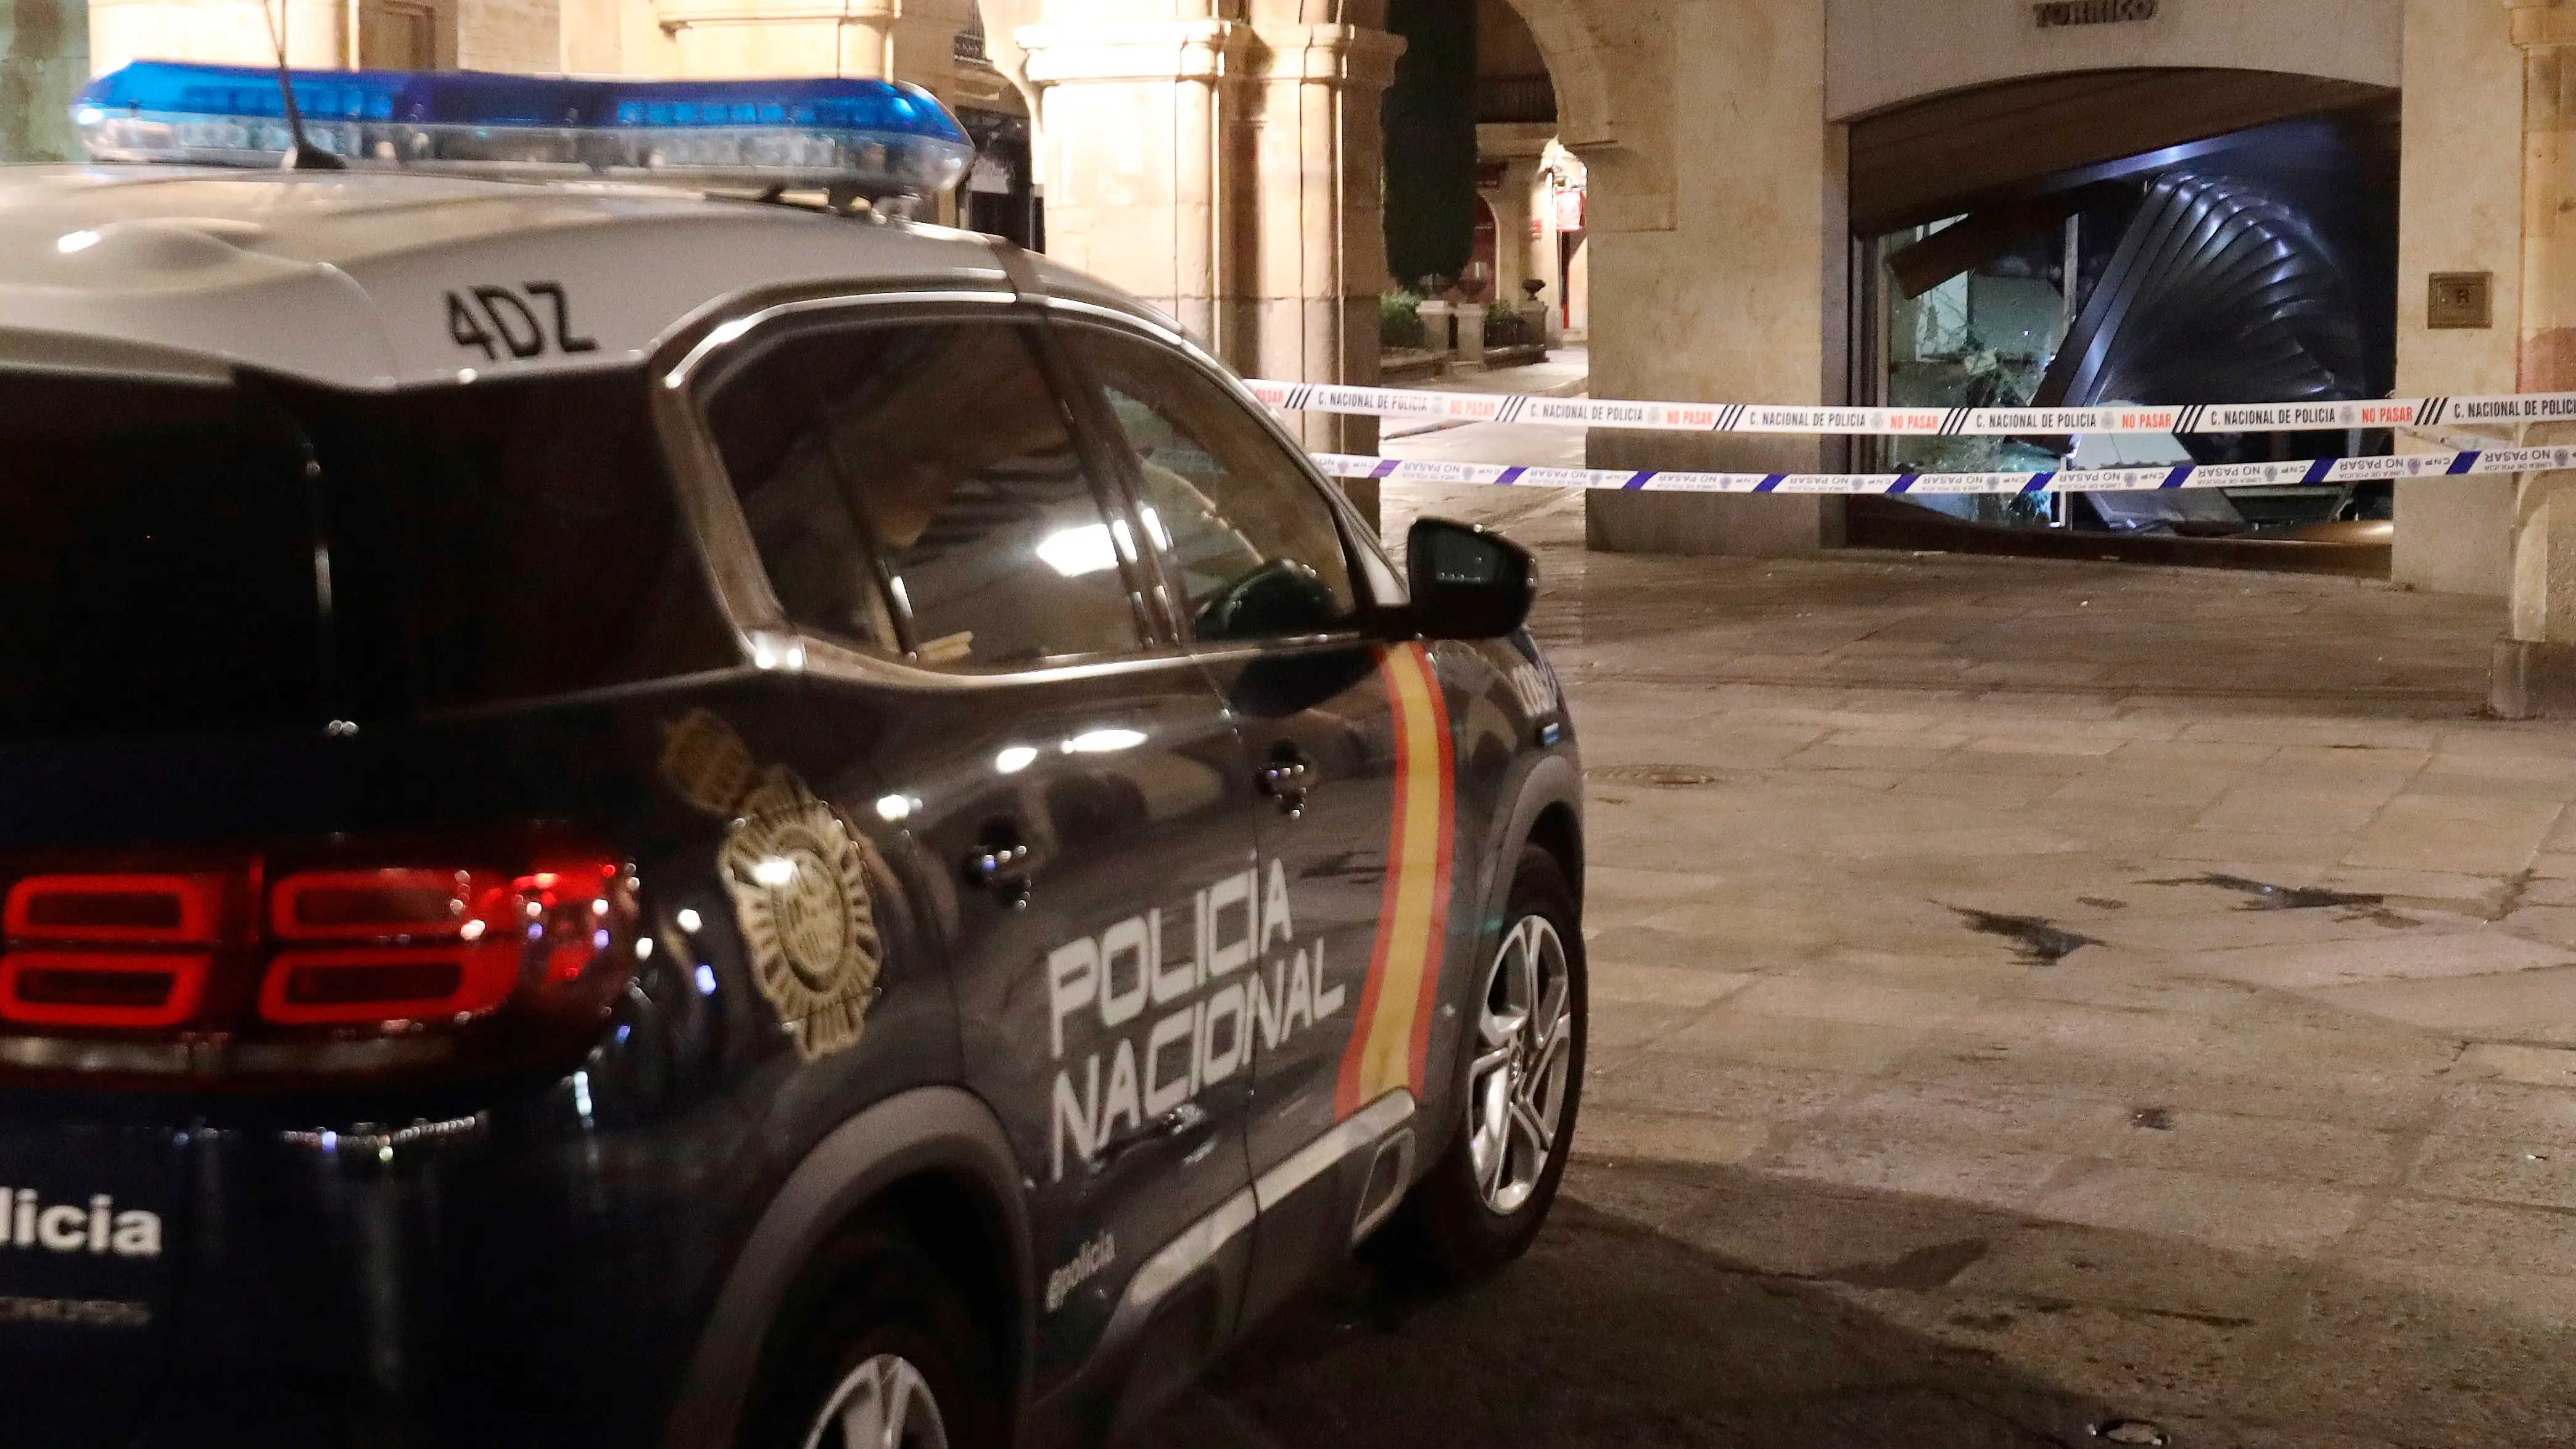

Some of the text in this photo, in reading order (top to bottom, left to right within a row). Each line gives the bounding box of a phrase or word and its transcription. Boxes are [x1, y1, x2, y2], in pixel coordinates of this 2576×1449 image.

[1543, 404, 1588, 419] NACIONAL
[1592, 406, 1603, 419] DE
[1607, 407, 1643, 421] POLICIA
[1667, 410, 1678, 424] NO
[1683, 411, 1713, 425] PASAR
[2224, 409, 2275, 426] NACIONAL
[2278, 408, 2291, 424] DE
[2295, 408, 2335, 424] POLICIA
[2361, 408, 2376, 423] NO
[2380, 406, 2414, 423] PASAR
[2468, 400, 2520, 418] NACIONAL
[2524, 400, 2538, 416] DE
[2542, 398, 2576, 415] POLICI
[1762, 411, 1809, 426] NACIONAL
[1813, 412, 1825, 427] DE
[1828, 413, 1866, 427] POLICIA
[1890, 415, 1904, 429] NO
[1907, 415, 1938, 429] PASAR
[1989, 413, 2038, 428] NACIONAL
[2042, 413, 2054, 427] DE
[2057, 413, 2097, 427] POLICIA
[2121, 413, 2136, 428] NO
[2139, 413, 2172, 428] PASAR
[2484, 449, 2551, 463] NO PASAR
[2197, 465, 2261, 478] NO PASAR
[2339, 458, 2404, 471] NO PASAR
[2058, 472, 2121, 482] NO PASAR
[1052, 936, 1346, 1183] NACIONAL
